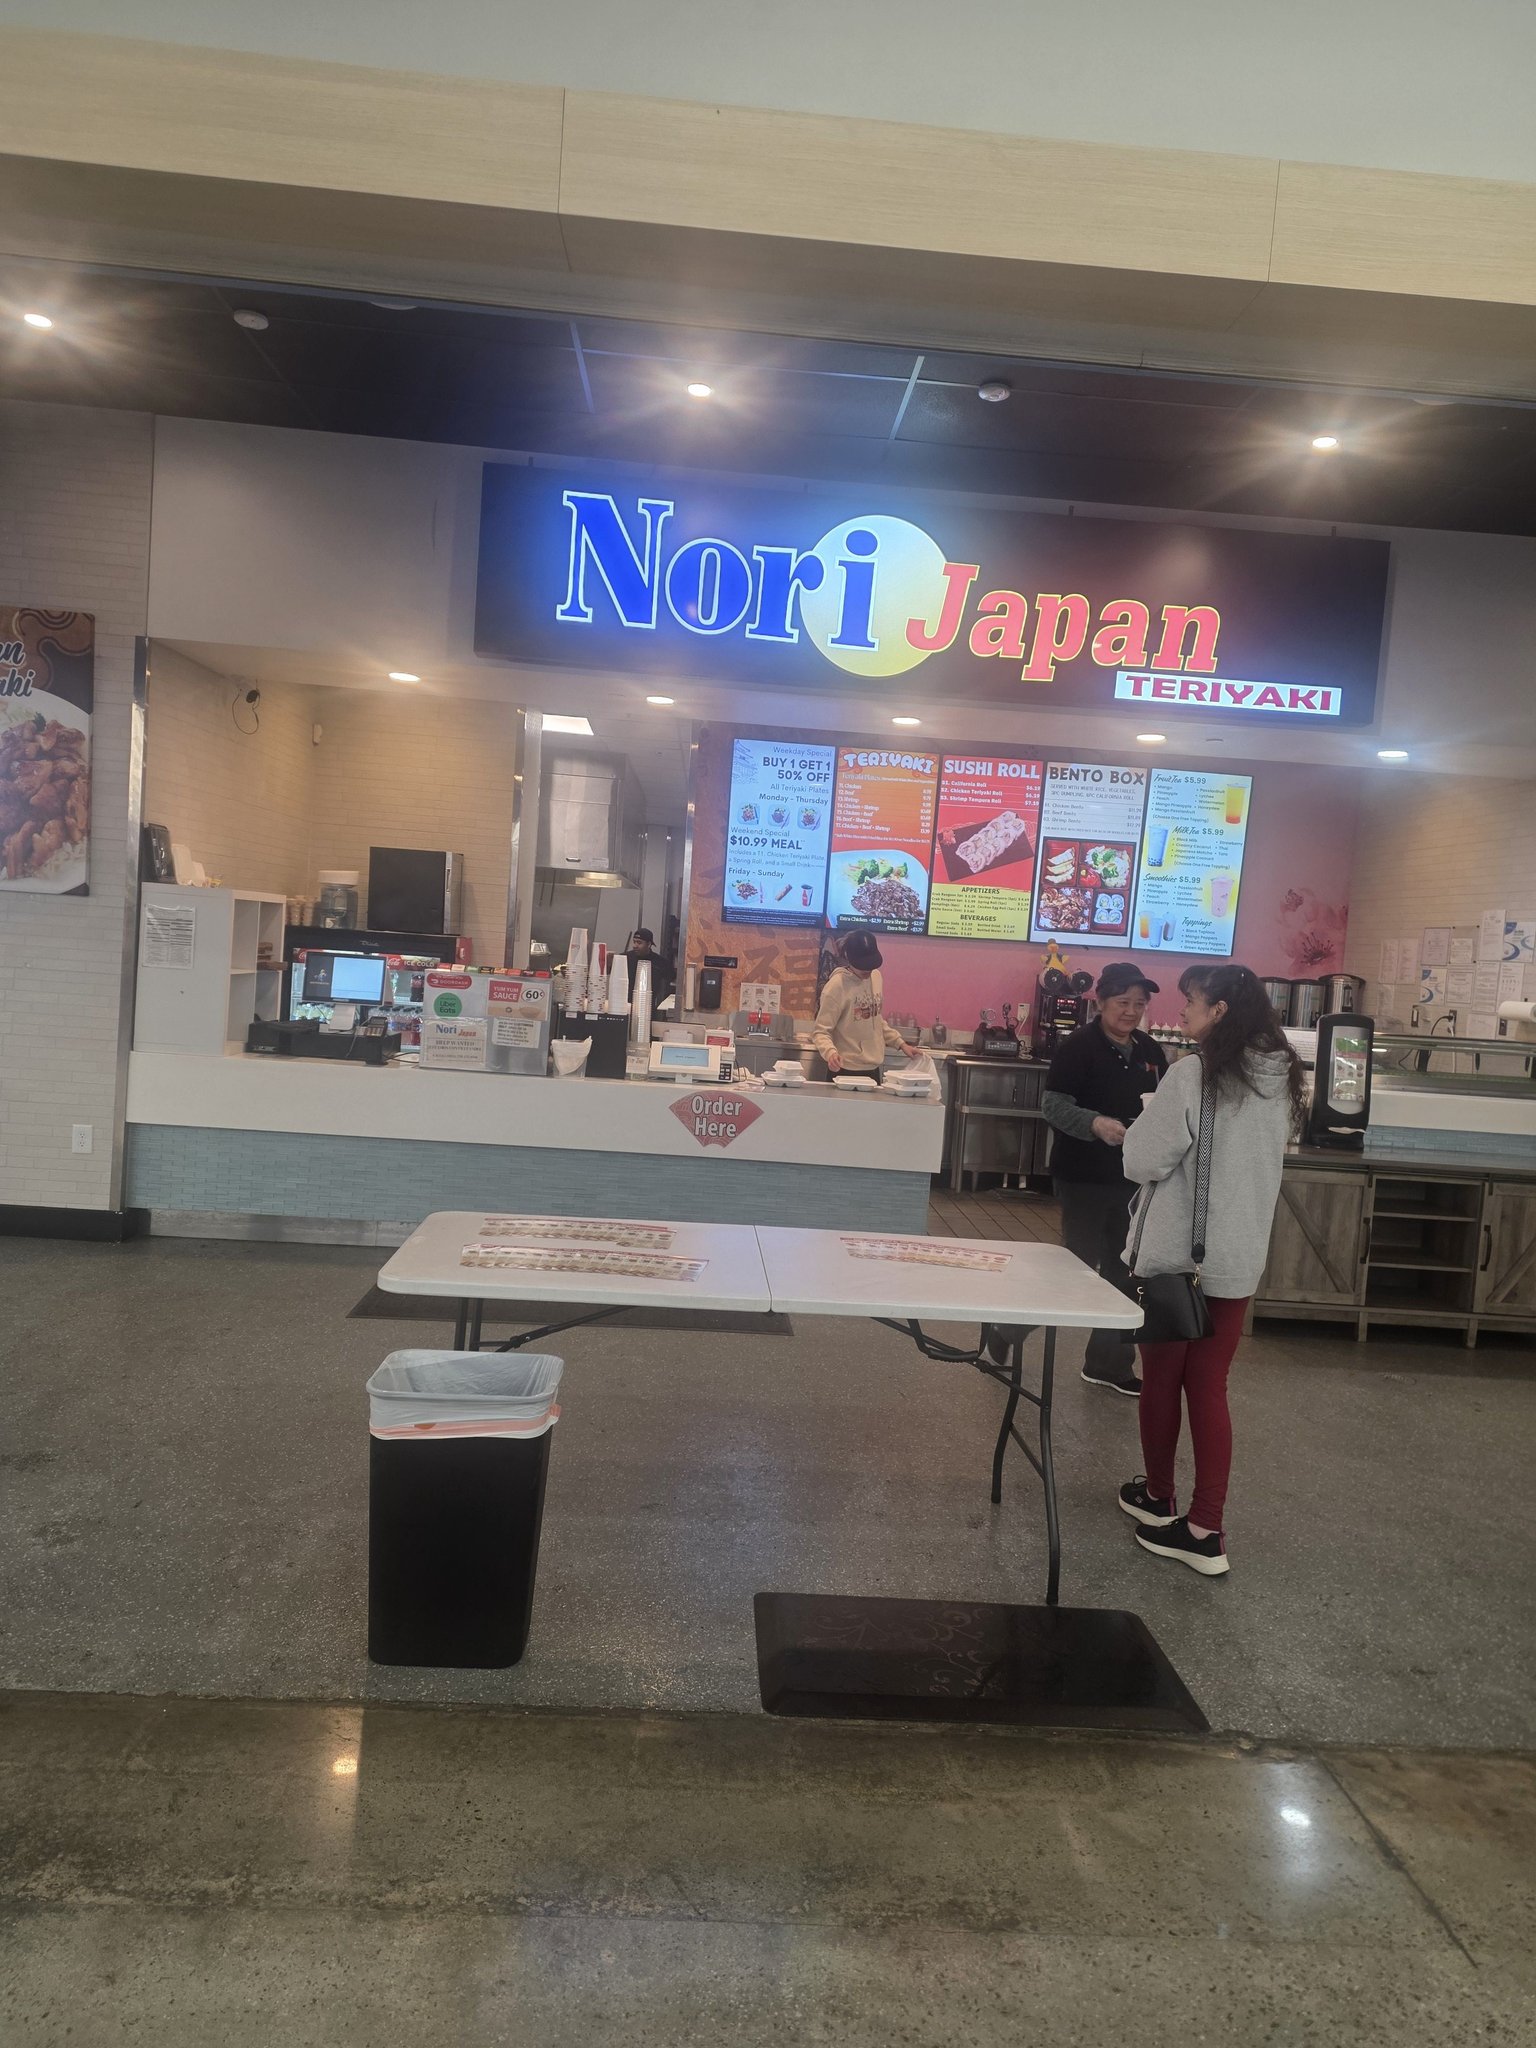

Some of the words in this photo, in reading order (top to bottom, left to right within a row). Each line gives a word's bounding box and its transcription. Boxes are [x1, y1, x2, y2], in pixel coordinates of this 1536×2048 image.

[556, 490, 879, 651] Nori
[904, 560, 1222, 683] Japan
[1125, 675, 1332, 711] TERIYAKI
[773, 746, 805, 756] Weekday
[806, 749, 832, 757] Special
[763, 757, 787, 767] BUY
[790, 759, 795, 768] 1
[799, 760, 823, 770] GET
[826, 761, 831, 771] 1
[843, 751, 935, 774] TERIYAKI
[944, 759, 993, 777] SUSHI
[997, 762, 1041, 779] ROLL
[778, 770, 802, 781] 50%
[806, 772, 830, 782] OFF
[1049, 767, 1103, 782] BENTO
[1109, 770, 1144, 785] BOX
[1184, 776, 1206, 785] $5.99
[782, 784, 806, 793] Teriyaki
[808, 786, 829, 794] Plates
[759, 793, 788, 803] Monday
[796, 796, 828, 806] Thursday
[730, 826, 763, 835] Weekend
[764, 828, 790, 837] Special
[1202, 828, 1224, 836] $5.99
[729, 835, 768, 848] $10.99
[728, 867, 751, 875] Friday
[757, 869, 785, 879] Sunday
[1143, 872, 1177, 883] Smoothies
[1179, 876, 1201, 884] $5.99
[960, 914, 997, 922] BEVERAGES
[1181, 916, 1213, 929] Toppings
[493, 991, 518, 1000] SAUCE
[435, 1023, 457, 1034] Nori
[691, 1095, 743, 1117] Order
[693, 1116, 737, 1138] Here
